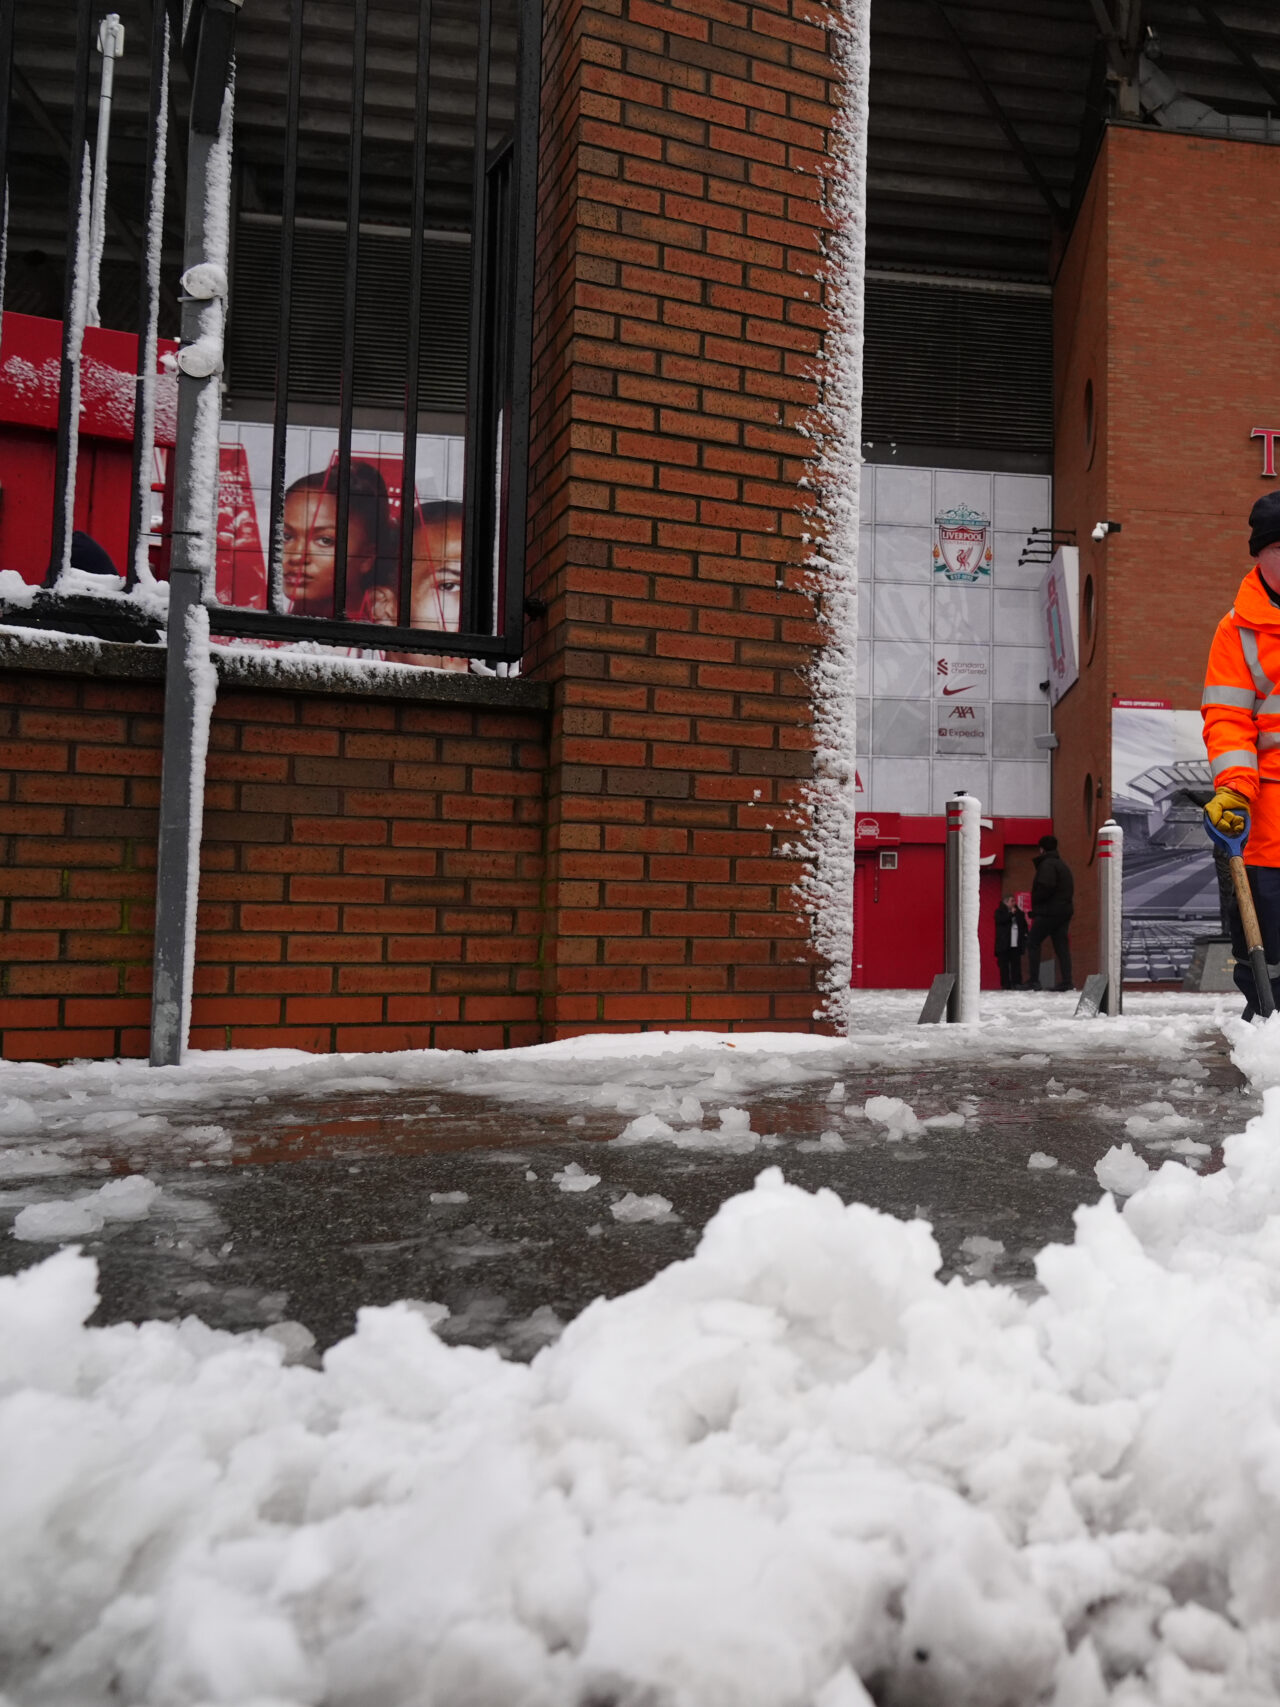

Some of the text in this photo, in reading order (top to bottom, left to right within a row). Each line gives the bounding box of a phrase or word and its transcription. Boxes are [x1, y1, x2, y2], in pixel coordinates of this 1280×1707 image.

[942, 532, 984, 541] LIVERPOOL
[948, 706, 976, 719] AXA
[948, 728, 985, 738] Expedia
